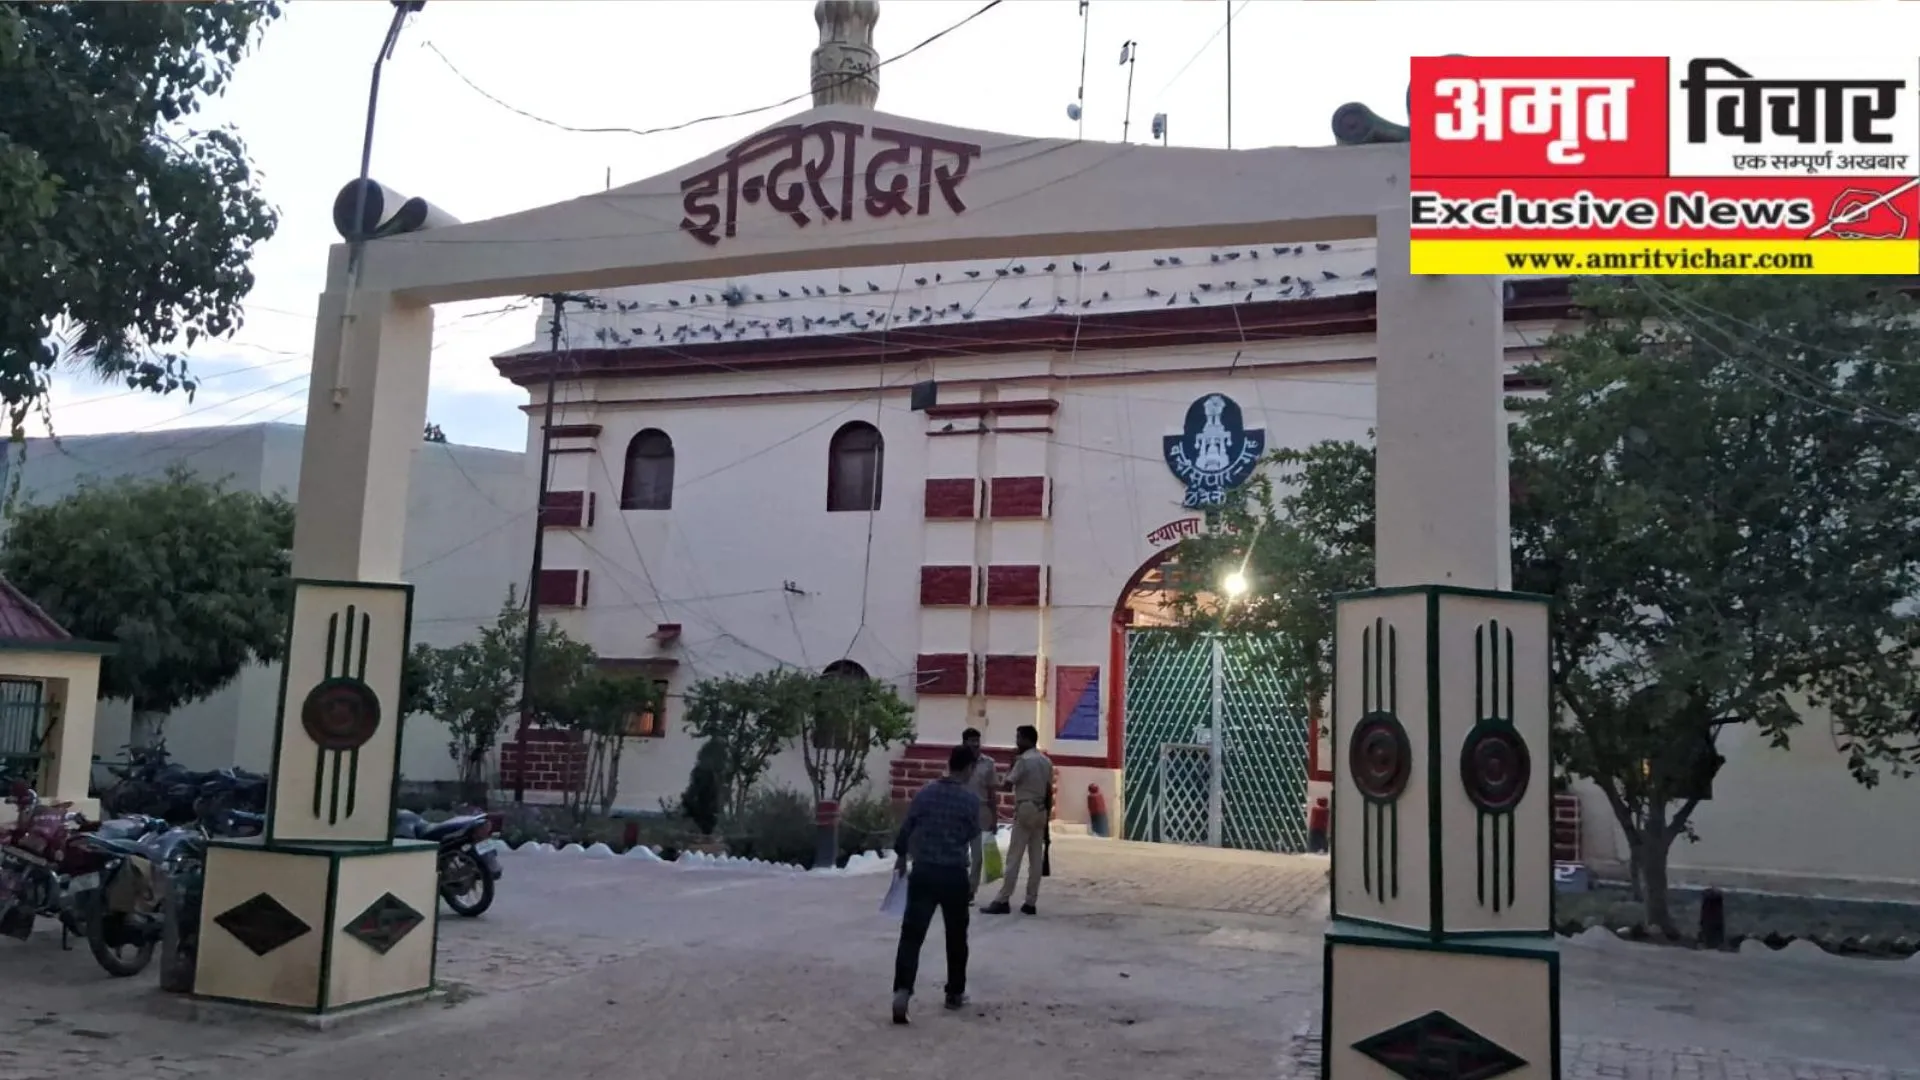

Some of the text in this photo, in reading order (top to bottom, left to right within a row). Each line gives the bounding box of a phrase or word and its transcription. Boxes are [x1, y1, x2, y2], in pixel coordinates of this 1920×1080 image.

[680, 120, 982, 245] इन्दिरा द्वार
[1147, 518, 1201, 546] स्थापना
